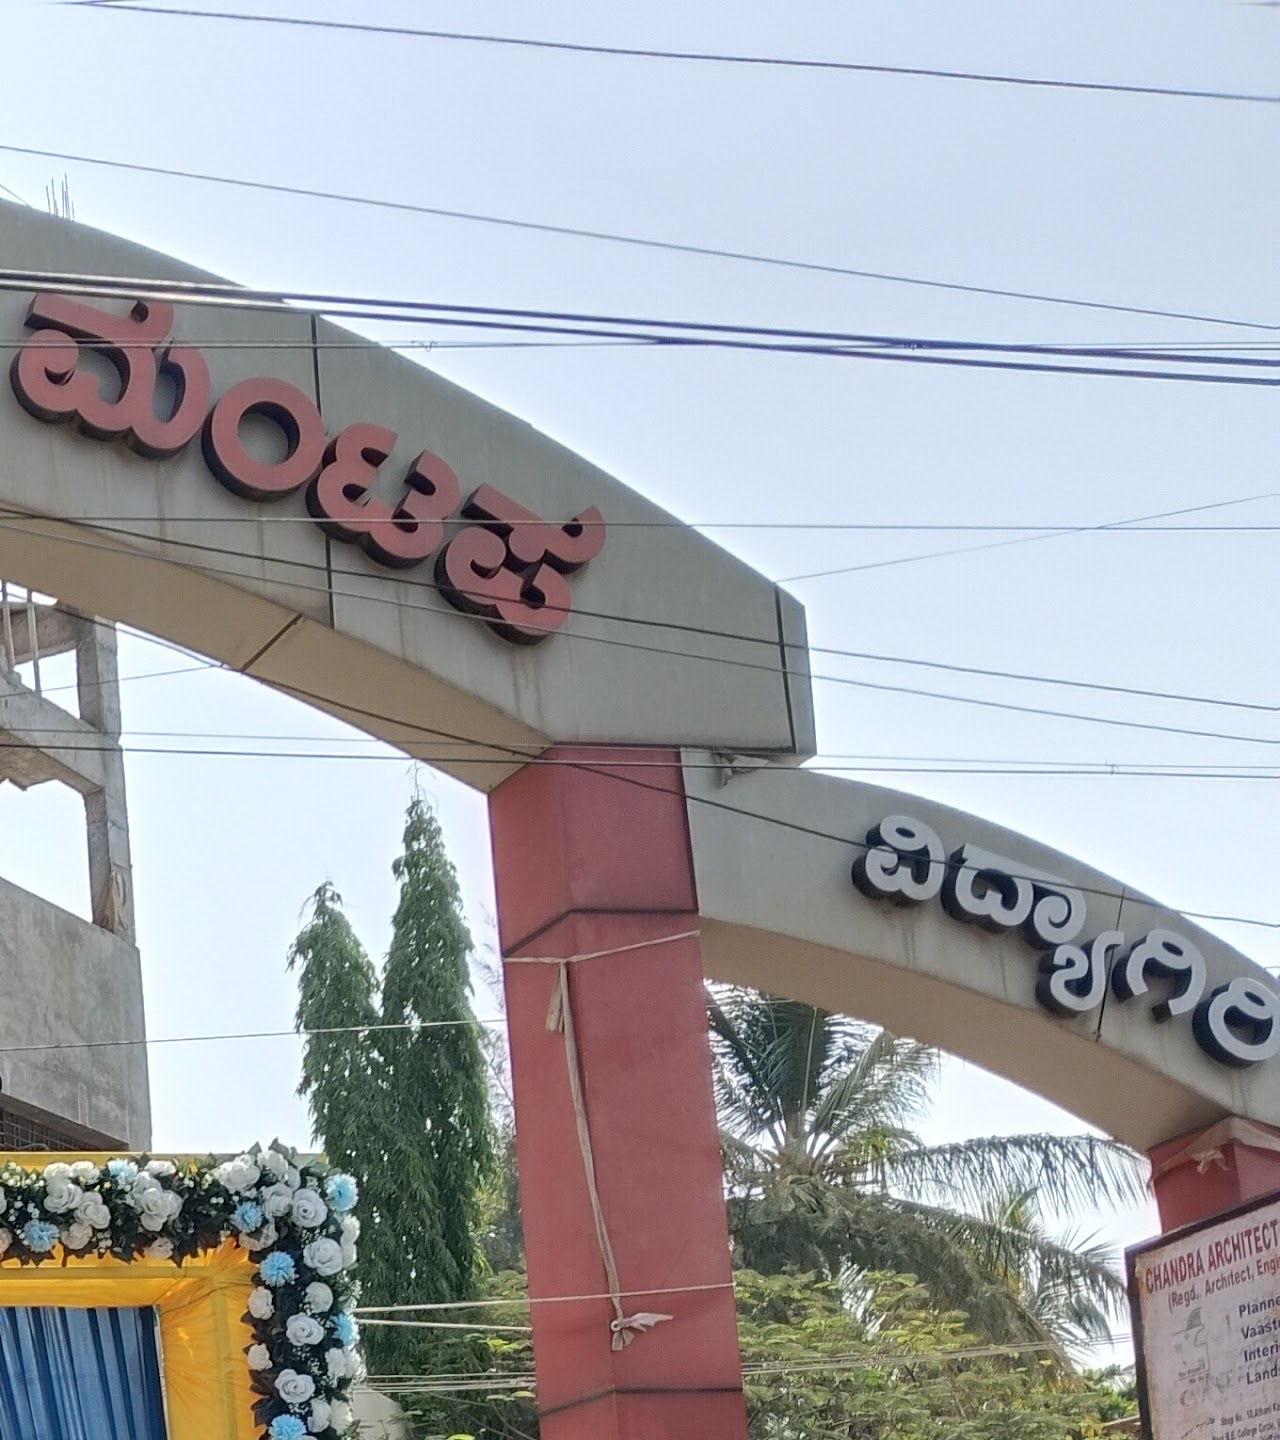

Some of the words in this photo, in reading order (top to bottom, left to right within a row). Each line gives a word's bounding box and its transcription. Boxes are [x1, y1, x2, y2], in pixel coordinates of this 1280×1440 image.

[9, 293, 606, 645] ಮಂಟಪ
[1146, 1248, 1205, 1294] CHANDRA
[1256, 1255, 1280, 1277] Engi
[1244, 1339, 1280, 1363] Interi
[1246, 1361, 1280, 1385] Land
